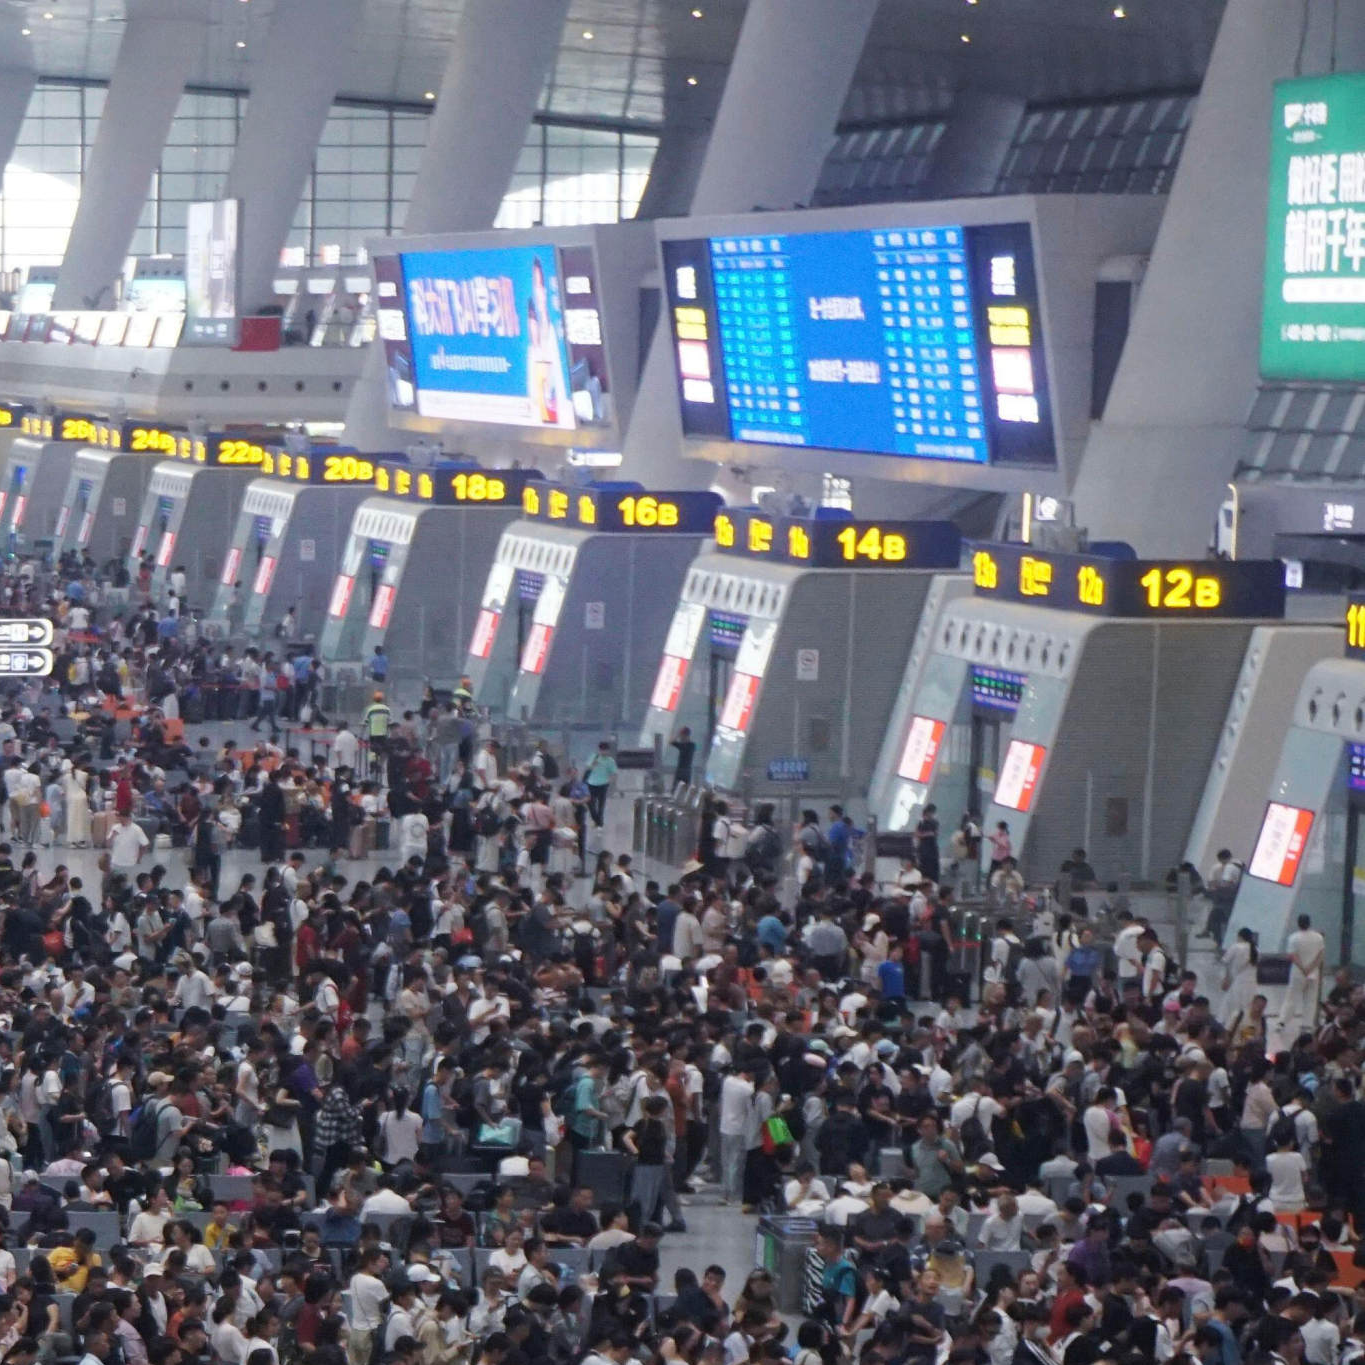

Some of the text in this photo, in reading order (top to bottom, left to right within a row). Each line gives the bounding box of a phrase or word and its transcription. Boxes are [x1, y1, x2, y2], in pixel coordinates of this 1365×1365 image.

[323, 456, 374, 481] 20B
[451, 474, 506, 501] 18B
[618, 496, 679, 526] 16B
[837, 526, 907, 561] 14B
[1141, 567, 1221, 608] 12B
